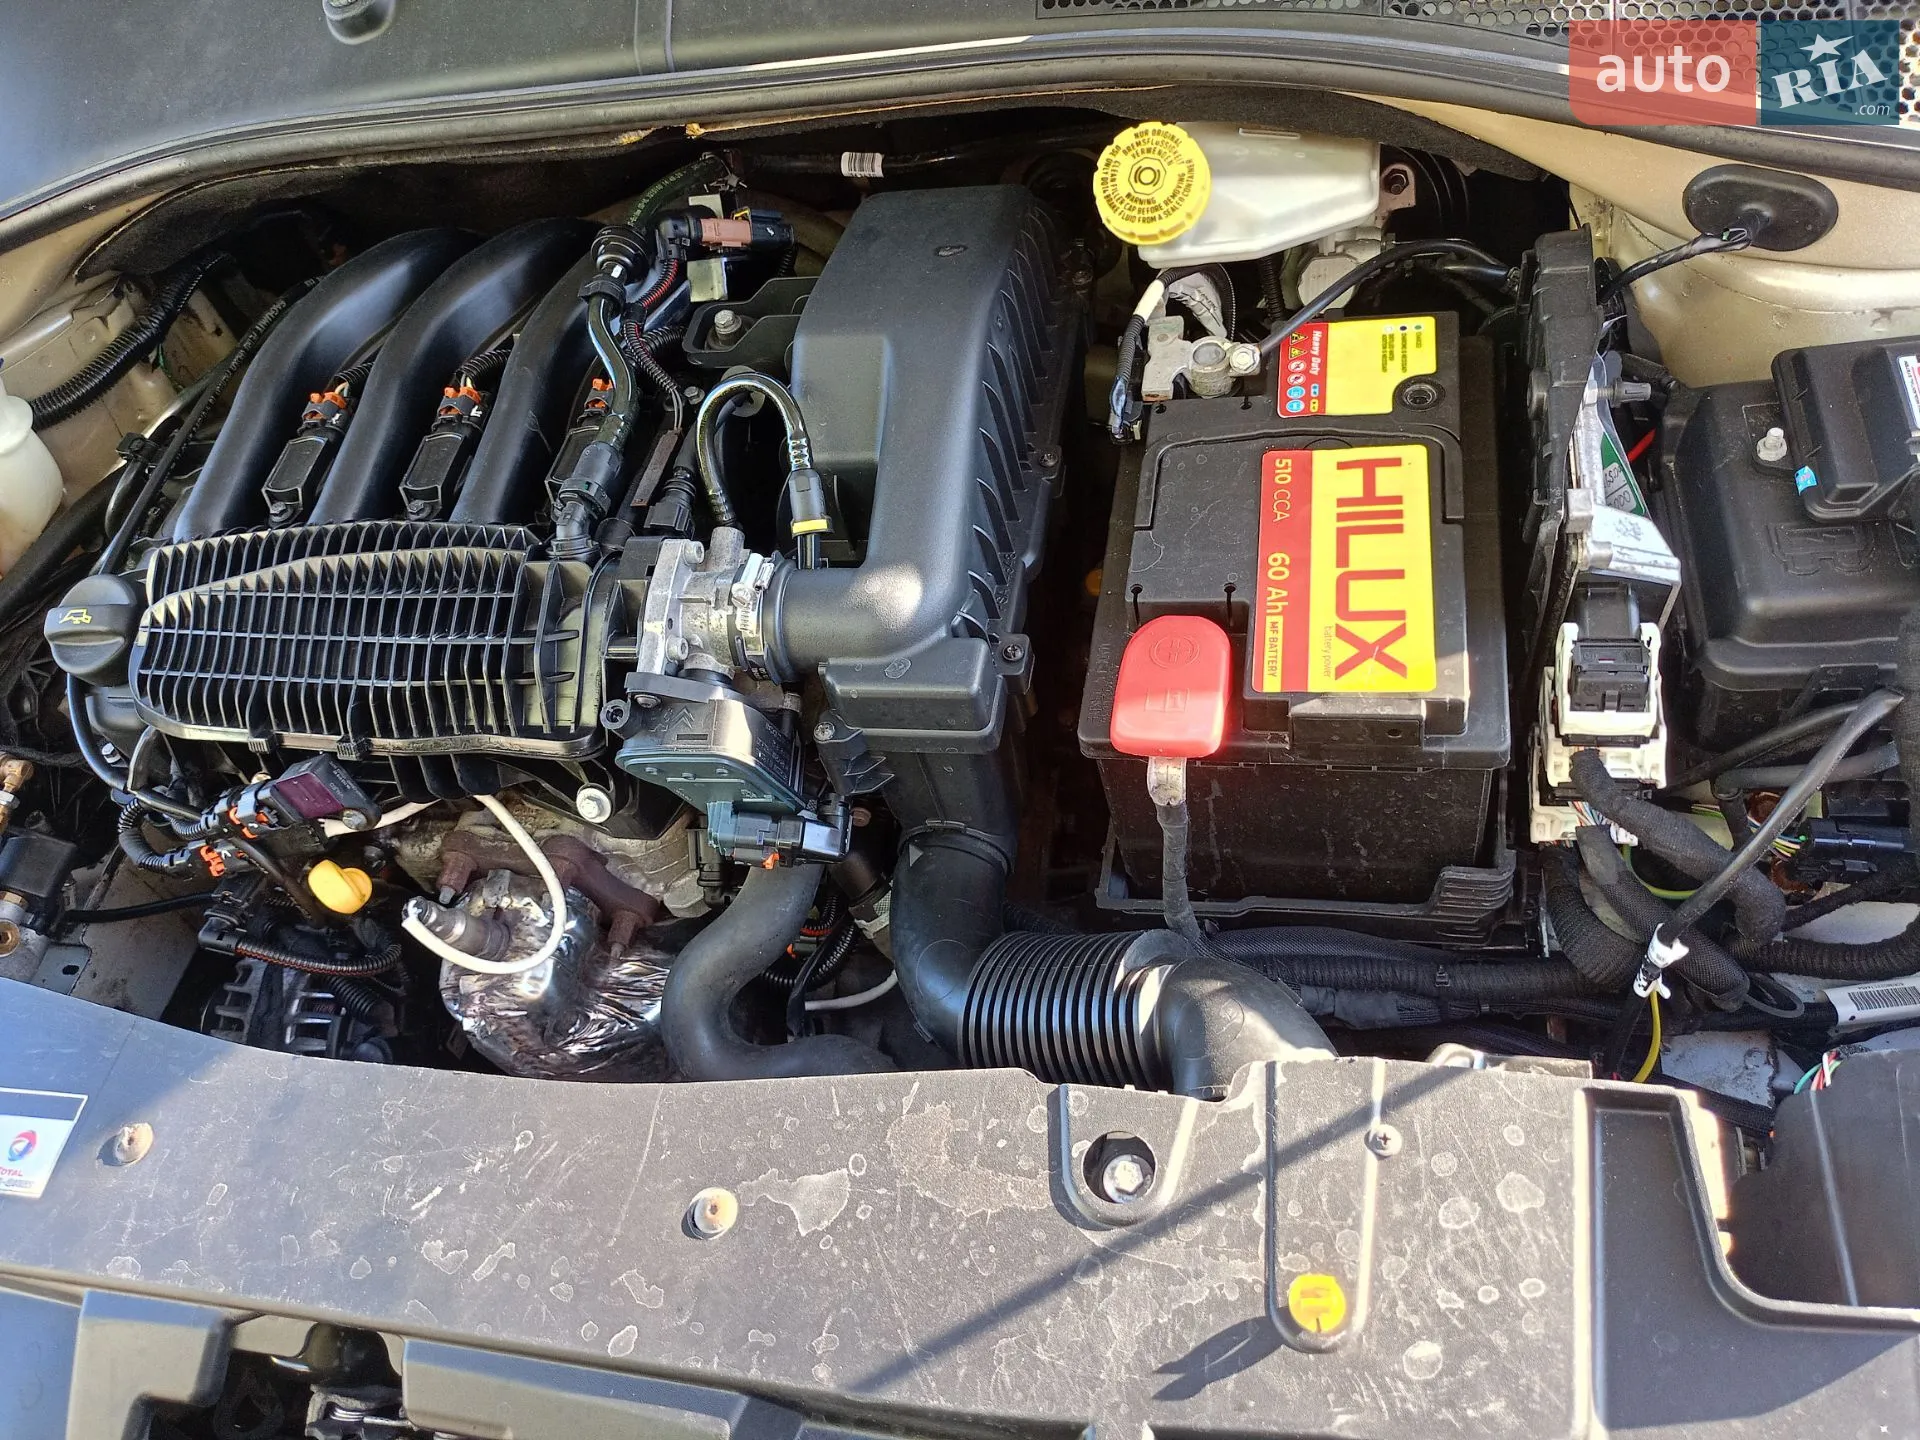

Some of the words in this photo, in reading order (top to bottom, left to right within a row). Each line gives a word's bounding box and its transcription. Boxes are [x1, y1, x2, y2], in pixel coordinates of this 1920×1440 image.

[1134, 129, 1149, 139] NUR
[1152, 129, 1182, 147] ORIGINAL
[1109, 145, 1121, 157] USE
[1131, 147, 1173, 166] VERWENDEN
[1102, 158, 1113, 174] ONLY
[1110, 160, 1121, 182] CLEAN
[1182, 159, 1195, 197] CONTAINER
[1110, 183, 1125, 206] FILLER
[1125, 192, 1156, 205] WARNING
[1163, 173, 1186, 206] REMOVING
[1104, 194, 1120, 214] BRAKE
[1124, 203, 1136, 212] CAP
[1137, 203, 1163, 215] BEFORE
[1163, 196, 1185, 218] SEALED
[1118, 210, 1137, 223] FLUID
[1310, 330, 1322, 356] Heavy
[1309, 357, 1321, 376] Duty
[1274, 458, 1292, 485] 510
[1272, 489, 1291, 523] CCA
[1267, 552, 1291, 581] 60
[1335, 457, 1408, 681] HILUX
[1266, 586, 1289, 616] Ah
[1269, 621, 1279, 635] MF
[1322, 625, 1333, 653] battery
[1267, 637, 1279, 678] BATTERY
[1321, 653, 1332, 678] power
